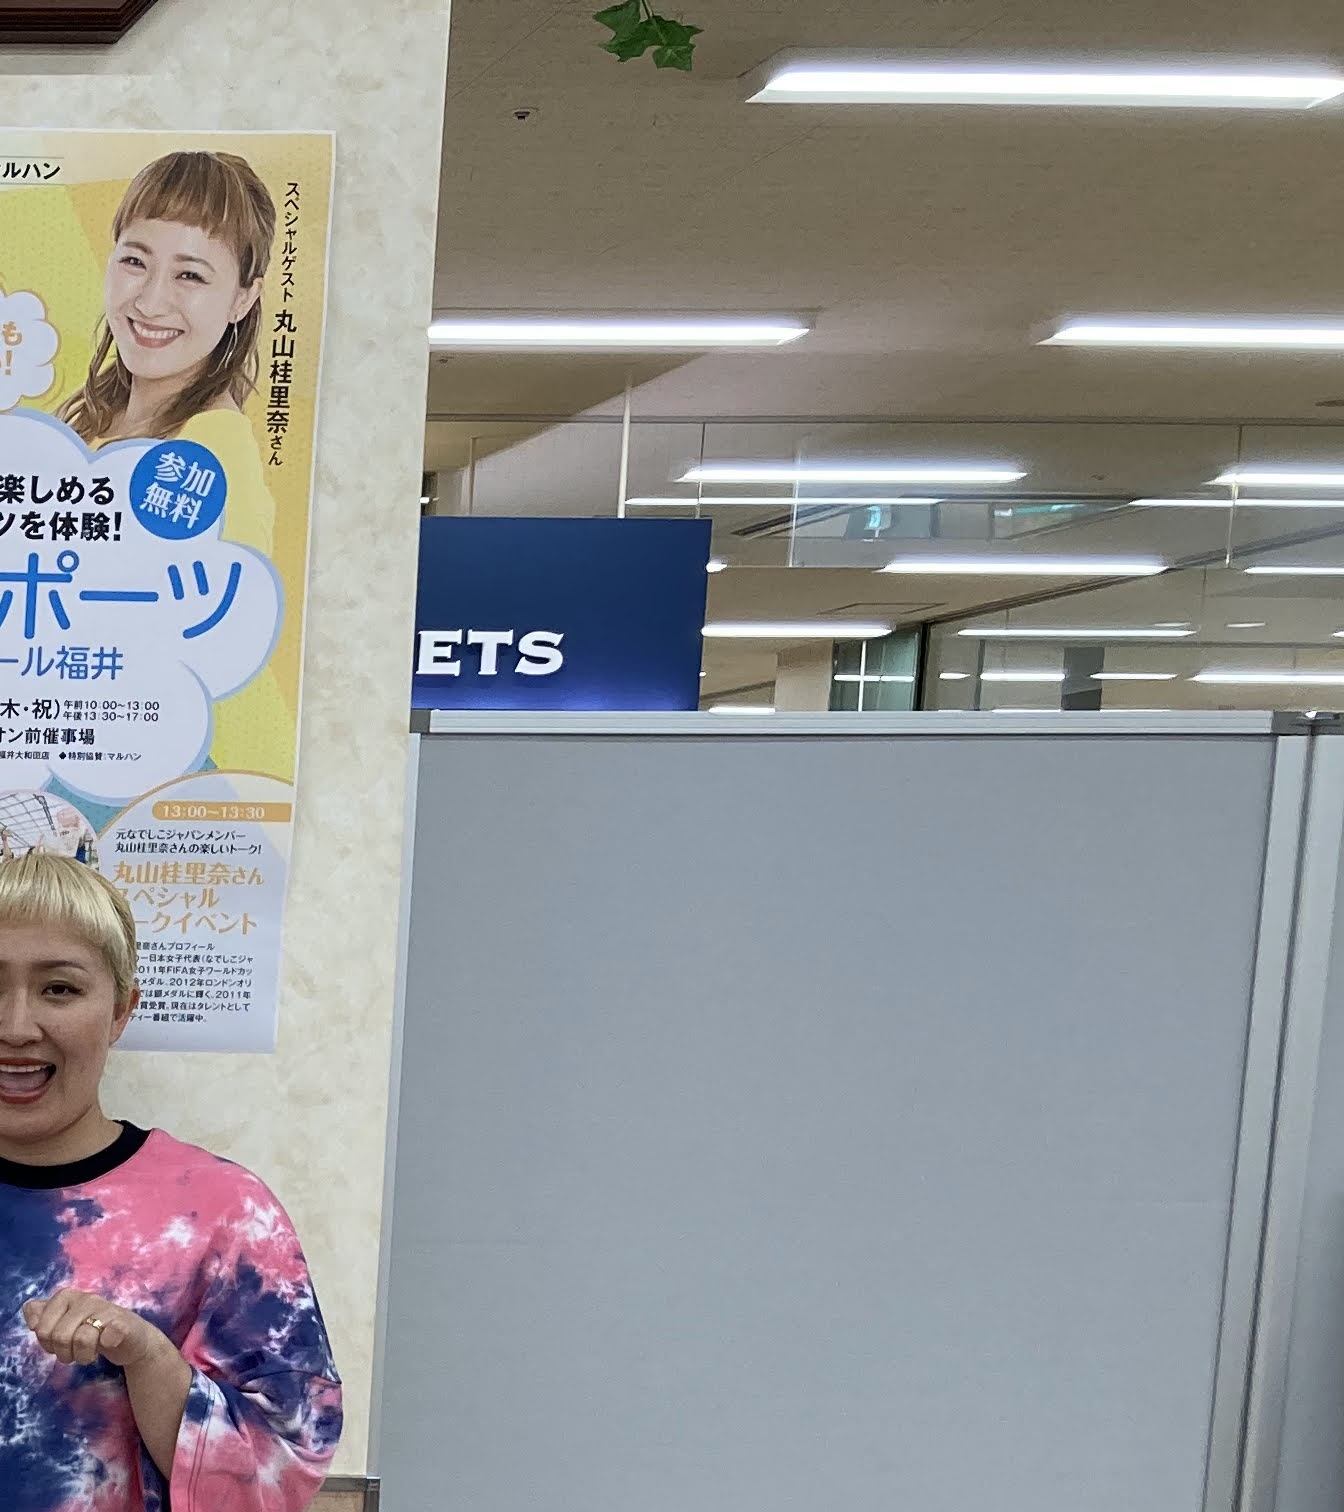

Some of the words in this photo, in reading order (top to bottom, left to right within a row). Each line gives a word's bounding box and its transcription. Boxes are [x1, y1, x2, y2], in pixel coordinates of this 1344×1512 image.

[279, 181, 301, 303] スペシャルゲスト
[266, 309, 297, 467] 丸山桂里奈さん
[153, 451, 216, 497] 参加
[141, 481, 204, 528] 無料
[417, 629, 566, 677] ETS
[115, 829, 247, 841] 元なでしこジャパンメンバー
[113, 860, 265, 885] 丸山桂里奈さん
[134, 911, 258, 935] ークイベント
